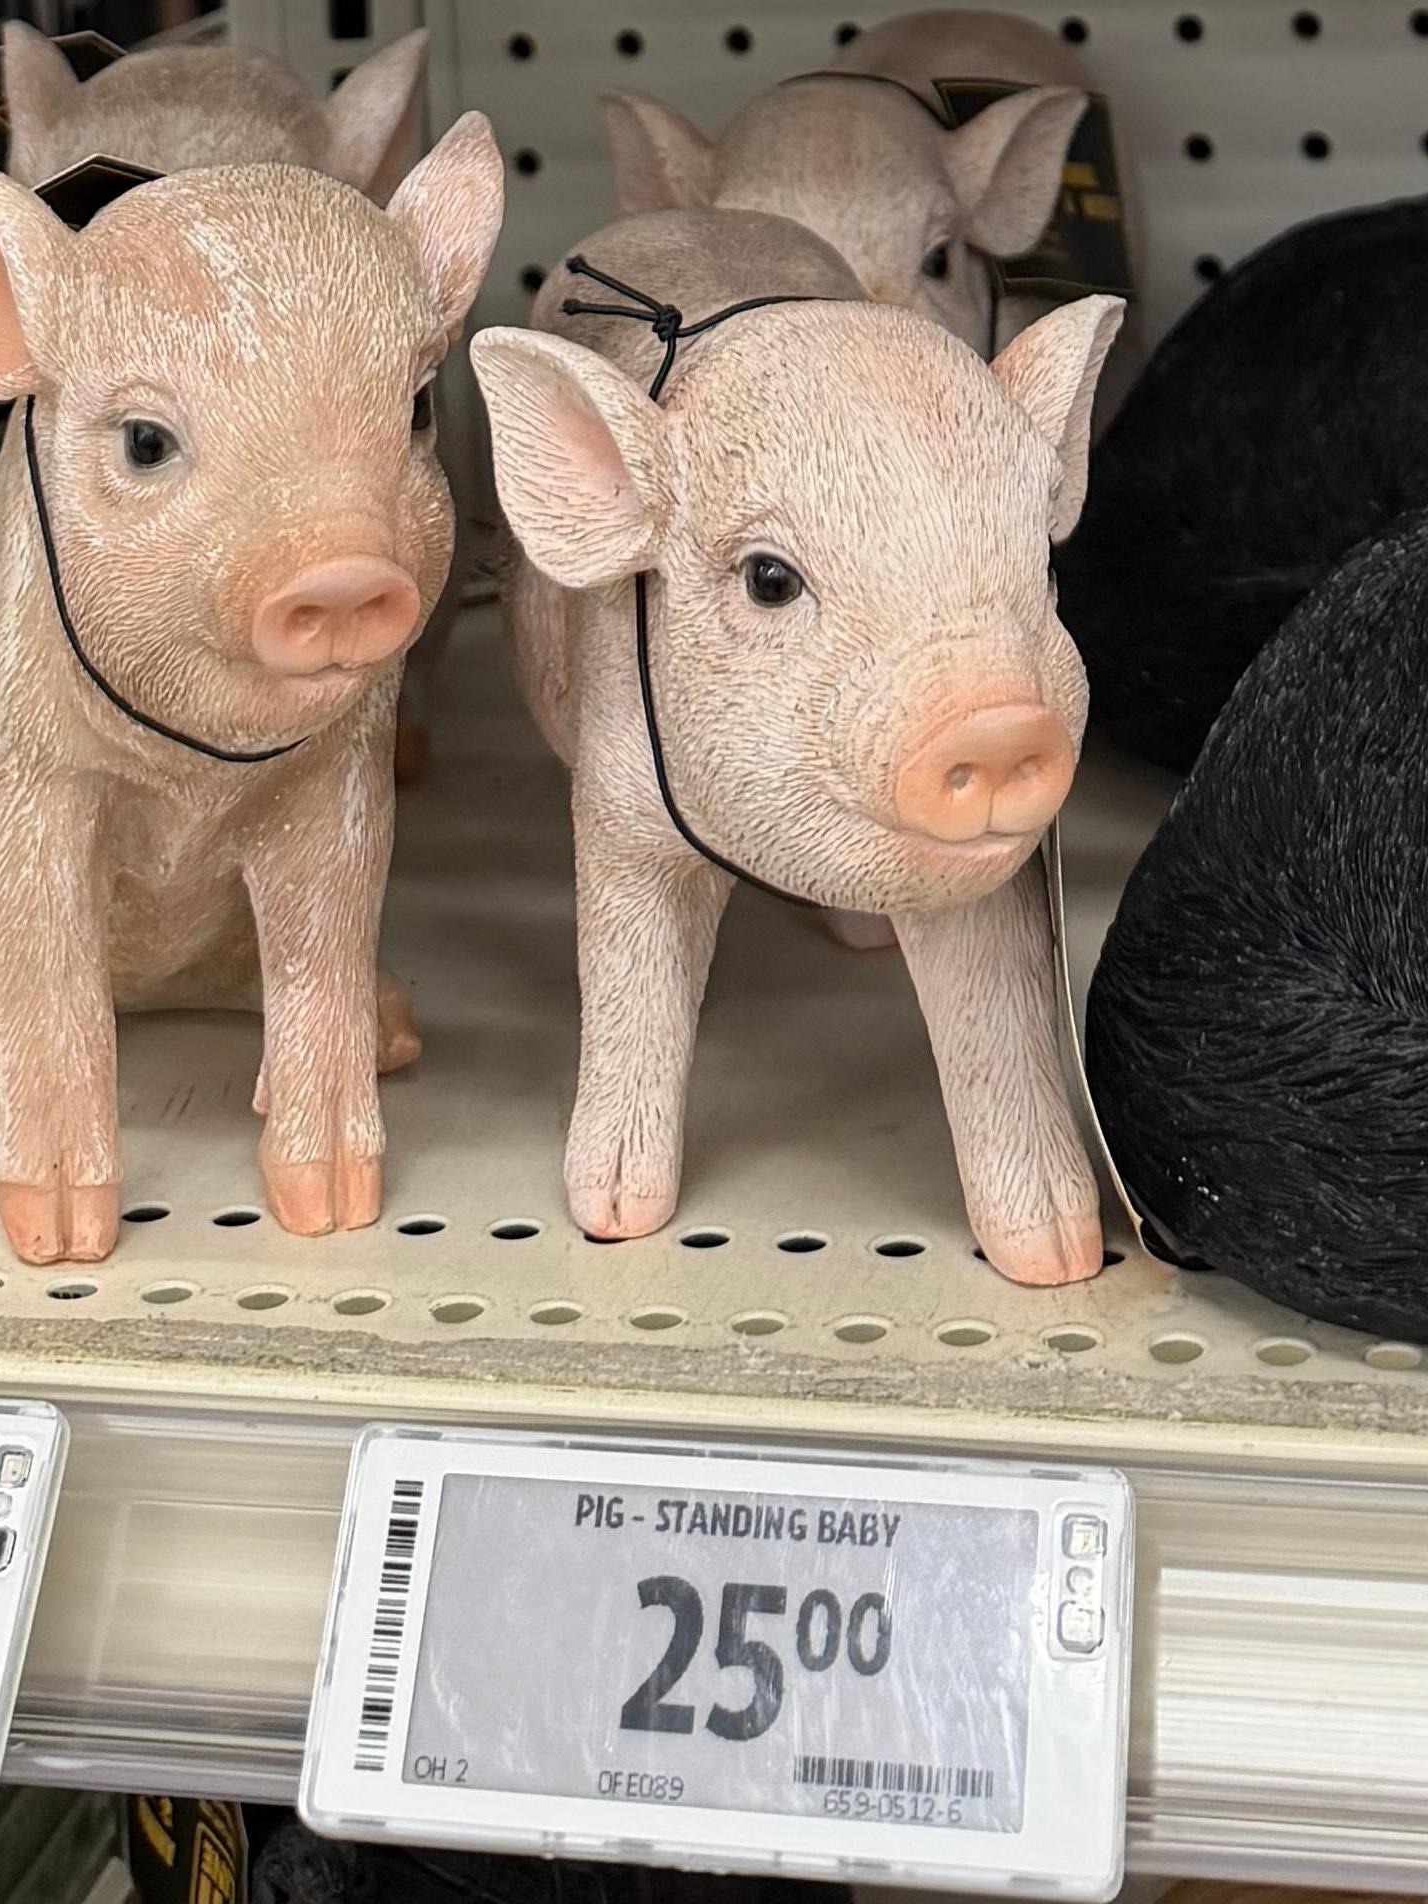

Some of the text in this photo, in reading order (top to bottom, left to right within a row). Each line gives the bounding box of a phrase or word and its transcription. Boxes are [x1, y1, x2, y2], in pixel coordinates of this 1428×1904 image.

[574, 1493, 900, 1548] PIG STANDING BABY
[414, 1755, 469, 1783] OH 2
[823, 1791, 963, 1824] 659-0512-6
